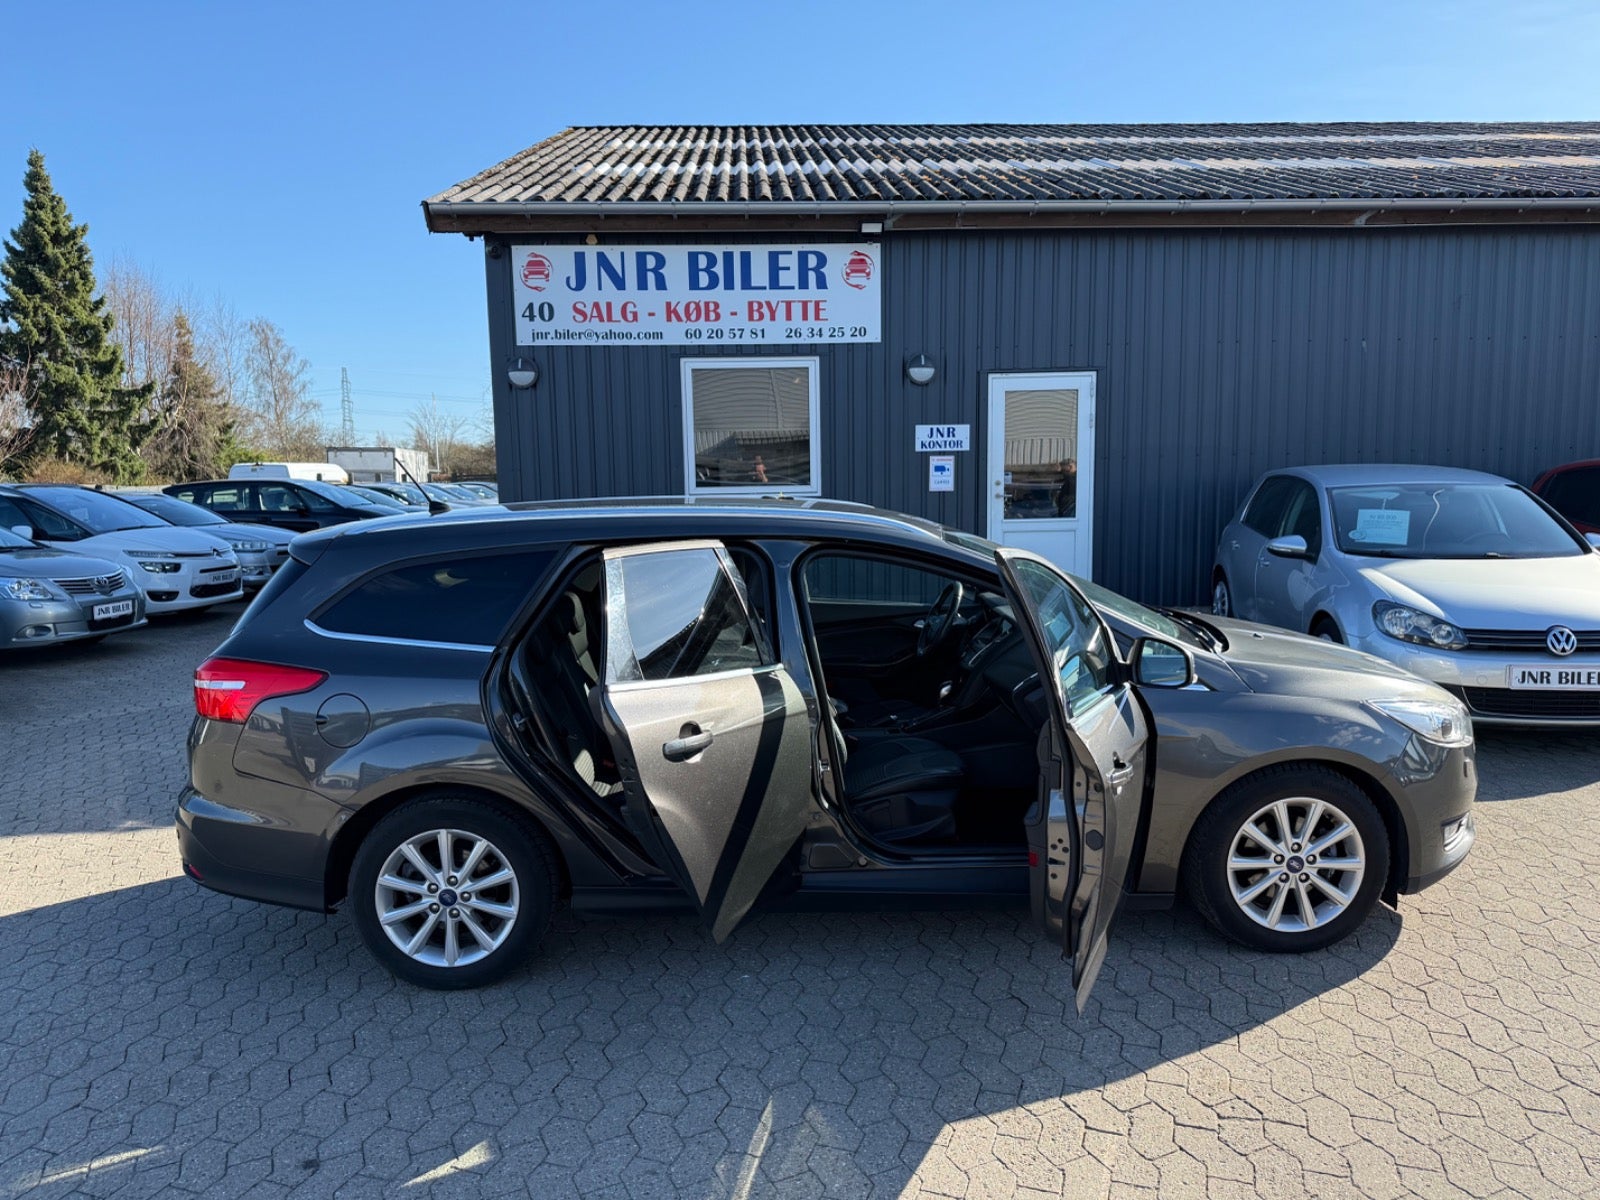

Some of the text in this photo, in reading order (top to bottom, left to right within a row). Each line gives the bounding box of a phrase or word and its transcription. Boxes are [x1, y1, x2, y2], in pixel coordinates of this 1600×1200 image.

[565, 250, 829, 292] JNR BILER
[521, 301, 555, 323] 40
[572, 300, 639, 324] SALG
[665, 300, 722, 324] KØB
[747, 299, 829, 322] BYTTE
[531, 328, 664, 343] jnr.biler@yahoo.com
[685, 327, 766, 340] 60 20 57 81
[785, 326, 867, 339] 26 34 25 20
[928, 427, 956, 439] JNR
[920, 440, 964, 449] KONTOR
[98, 602, 131, 616] JNR BILER
[1547, 625, 1577, 656] VW
[1518, 670, 1600, 685] JNR BILE
